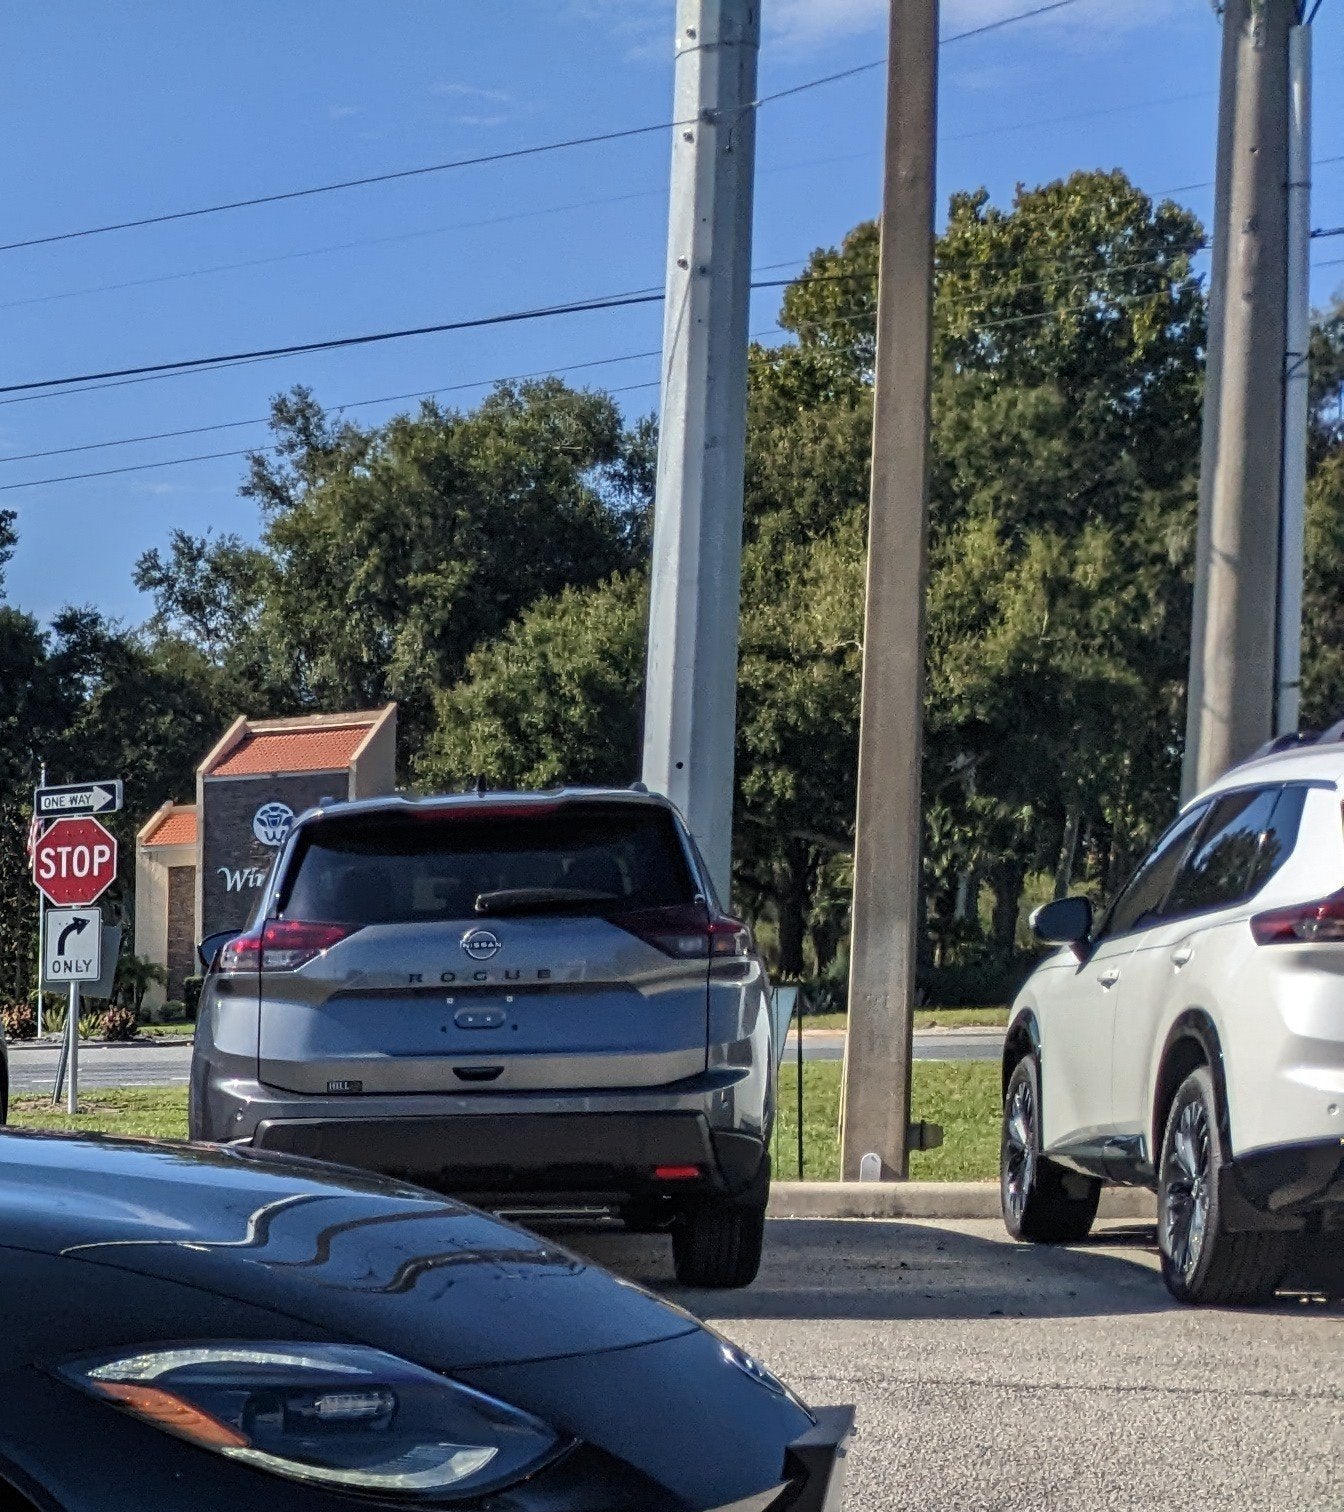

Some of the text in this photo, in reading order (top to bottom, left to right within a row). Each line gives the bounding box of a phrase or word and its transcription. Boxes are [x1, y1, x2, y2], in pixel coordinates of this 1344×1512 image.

[44, 794, 92, 809] ONE WAY
[39, 845, 111, 880] STOP
[462, 941, 502, 949] NISSAN
[52, 960, 93, 974] ONLY
[408, 969, 552, 983] ROGUE
